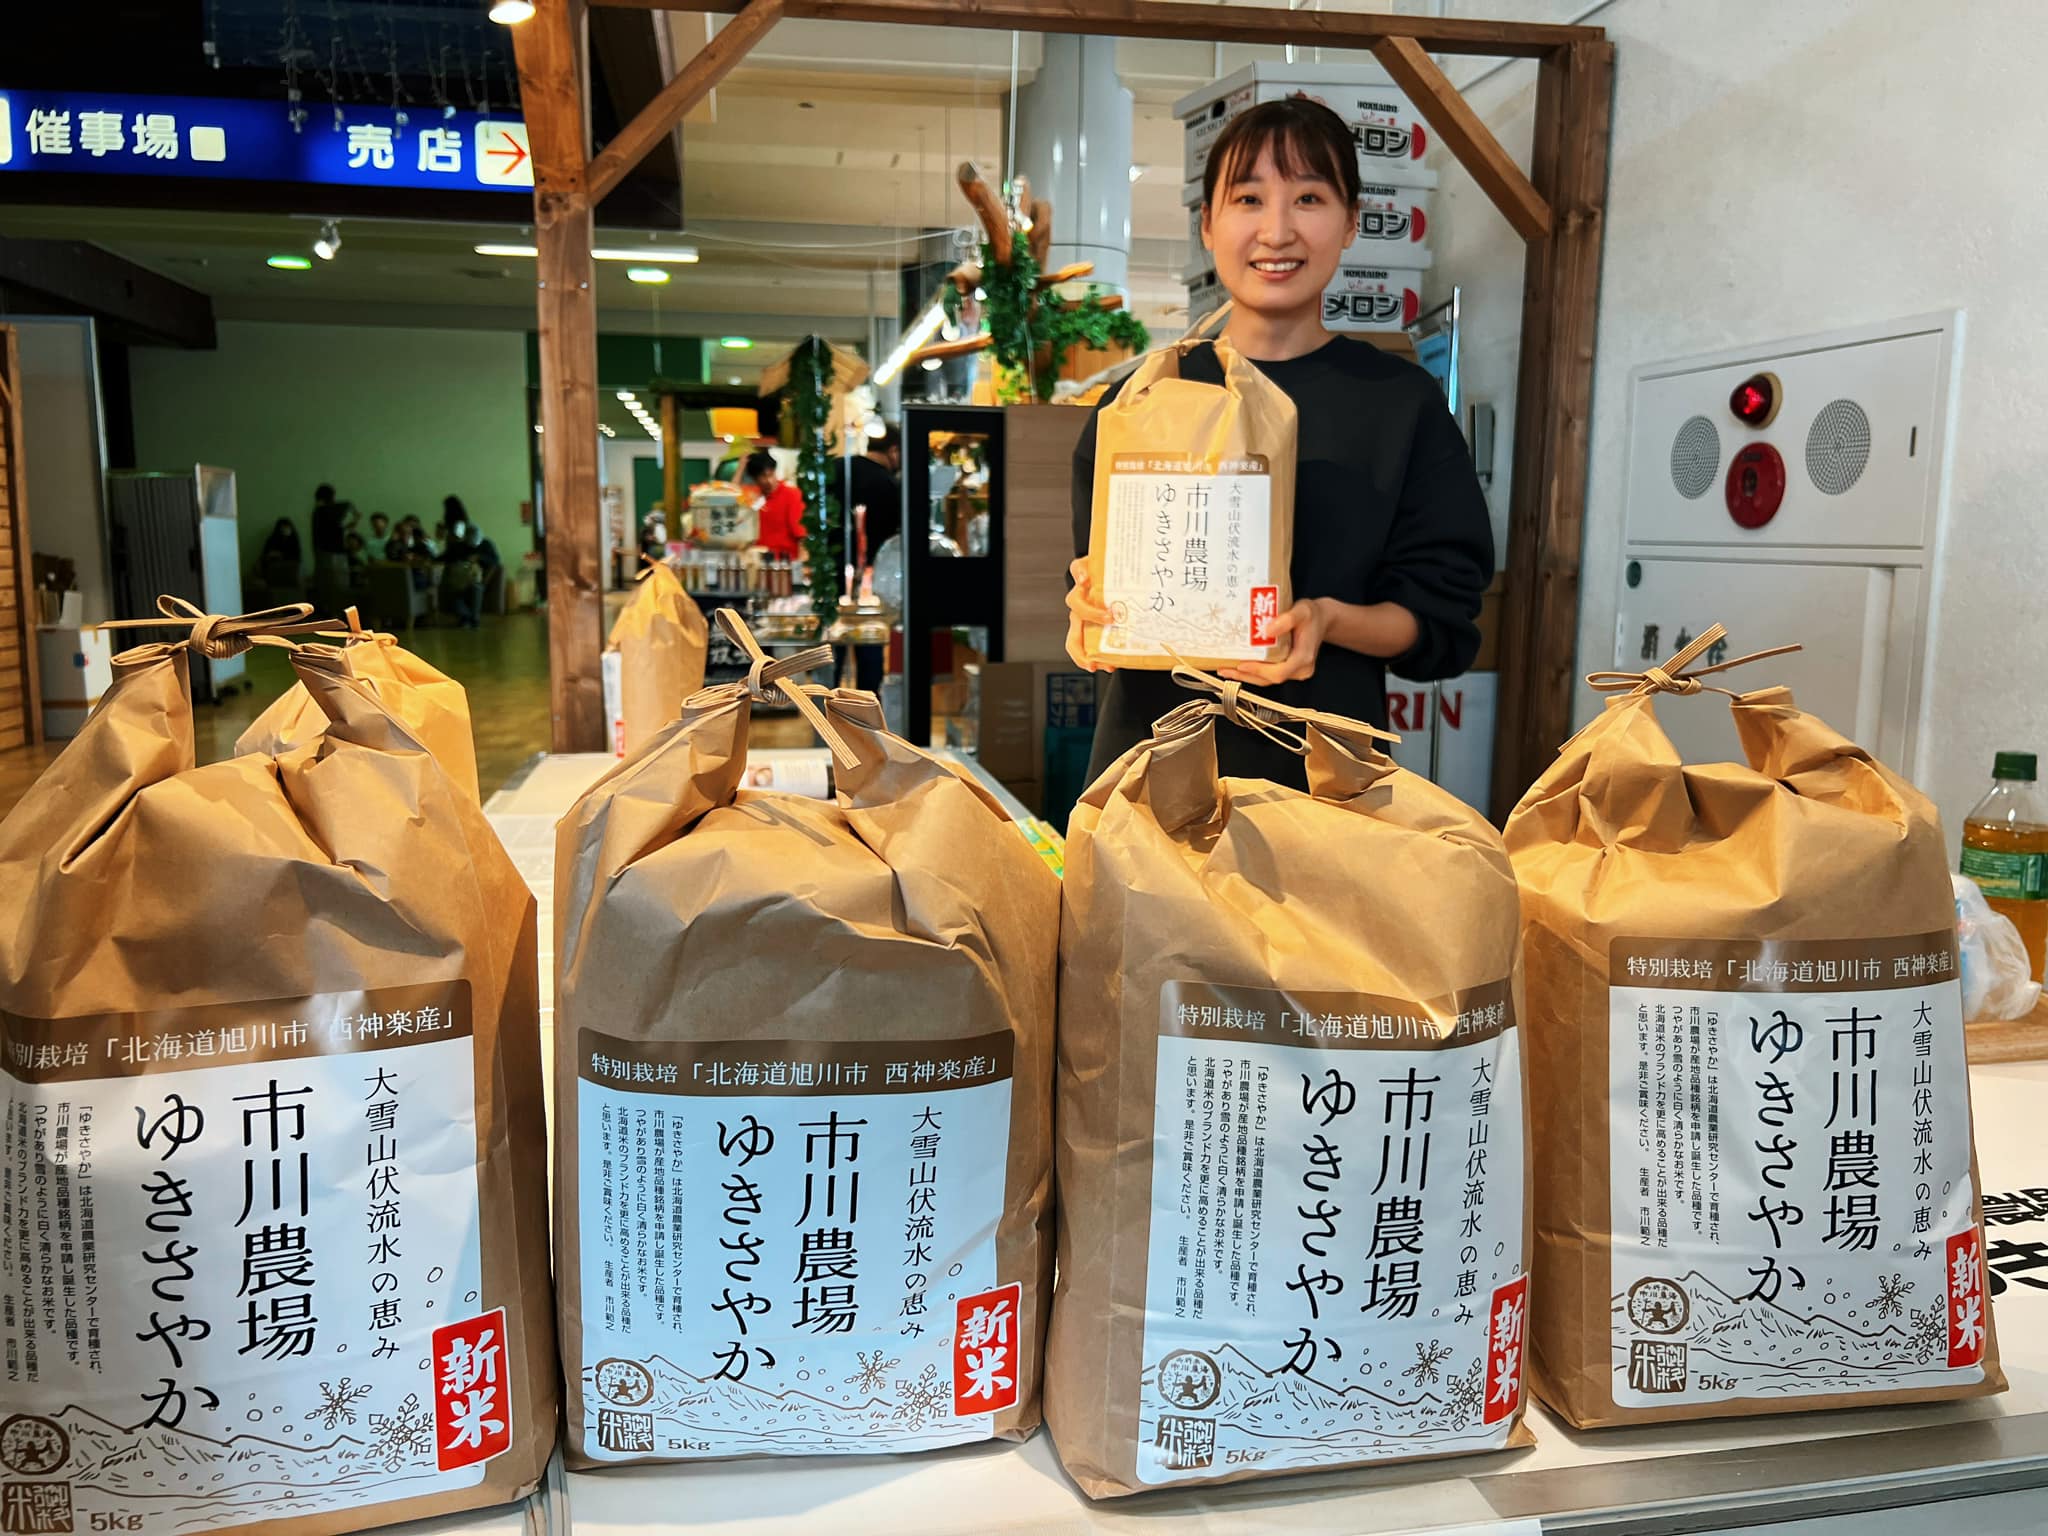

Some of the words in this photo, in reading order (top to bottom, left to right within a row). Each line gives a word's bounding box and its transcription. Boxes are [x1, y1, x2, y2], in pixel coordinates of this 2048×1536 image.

[25, 108, 179, 160] 催事場
[347, 123, 463, 172] 売店
[1357, 101, 1398, 113] HOKKAIDO
[1343, 269, 1388, 280] HOKKAIDO
[1357, 209, 1411, 240] ロン
[1322, 291, 1403, 323] メロン
[1151, 483, 1177, 613] ゆきさやか
[1183, 482, 1213, 593] 市川農場
[1178, 1003, 1266, 1030] 特別栽培
[1627, 956, 1712, 979] 特別栽培
[8, 1042, 88, 1070] 別栽培
[592, 1052, 678, 1084] 特別栽培
[1748, 1010, 1806, 1303] ゆきさやか
[1822, 1007, 1882, 1252] 市川農場
[1912, 1001, 1933, 1260] 大雪山伏流水の恵み
[232, 1079, 319, 1361] 市川農場
[364, 1066, 403, 1360] 大雪山伏流水の恵み
[792, 1111, 868, 1335] 市川農場
[900, 1106, 943, 1340] 大雪山伏流水の恵み
[1283, 1069, 1356, 1375] ゆきさやか
[1360, 1067, 1441, 1320] 市川農場
[1454, 1057, 1492, 1326] 大雪山伏流水の恵み
[135, 1093, 221, 1430] ゆきさやか
[711, 1115, 776, 1382] ゆきさやか
[1951, 1241, 1983, 1351] 新米
[441, 1329, 505, 1450] 新米
[960, 1300, 1013, 1400] 新米
[1488, 1293, 1523, 1405] 新米
[1698, 1375, 1739, 1390] 5kg
[668, 1439, 711, 1451] 5kg
[1225, 1449, 1268, 1464] 5kg
[90, 1512, 143, 1532] 5kg
